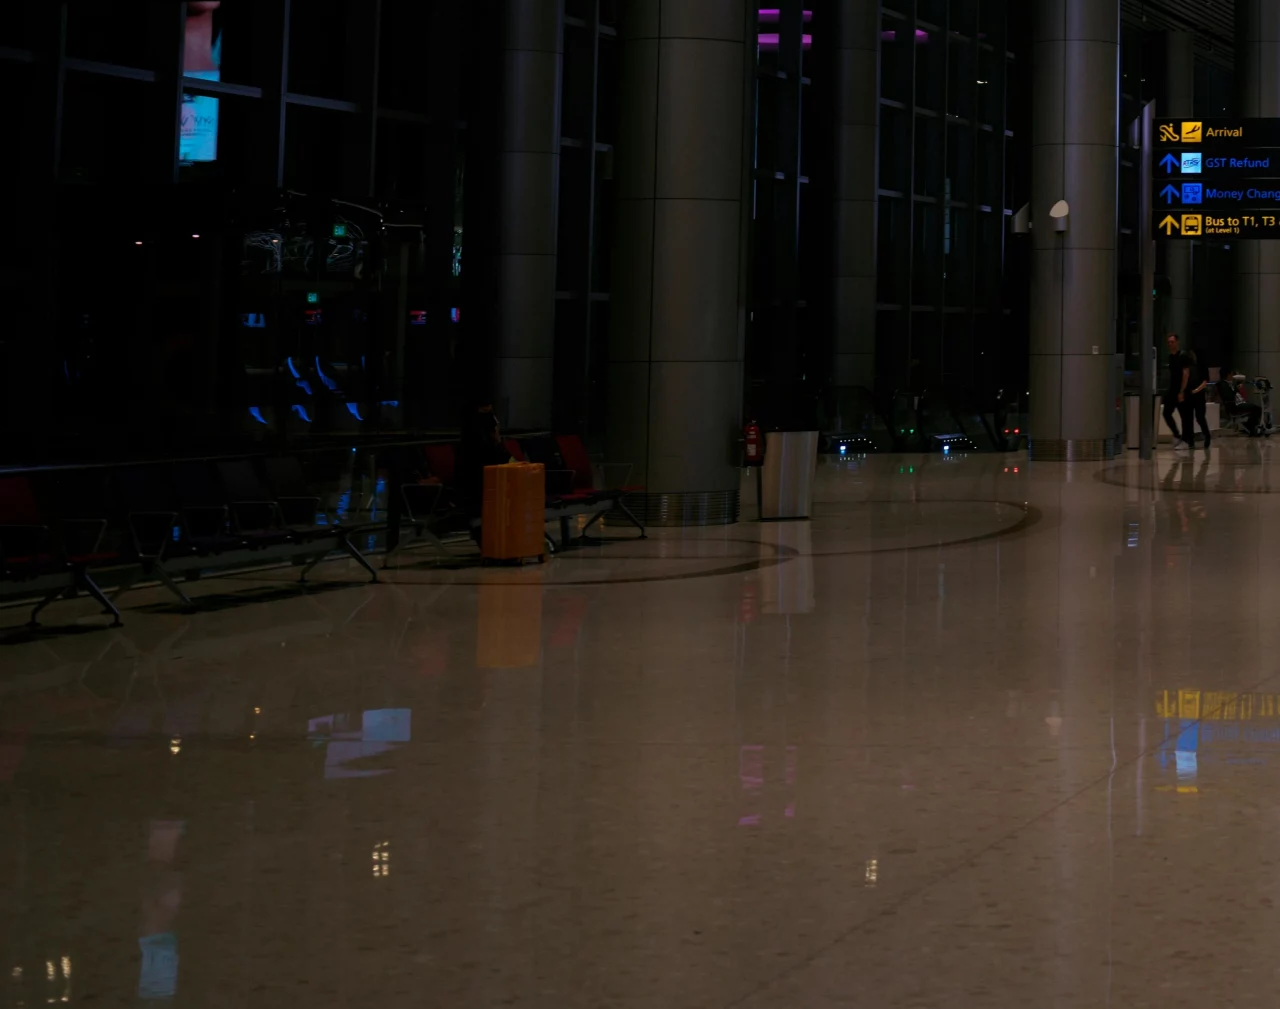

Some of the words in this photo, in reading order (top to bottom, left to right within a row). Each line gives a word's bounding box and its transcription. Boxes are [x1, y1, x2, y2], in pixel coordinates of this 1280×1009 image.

[1206, 126, 1243, 137] Arrival
[1206, 158, 1227, 168] GST
[1229, 157, 1270, 168] Refund
[1206, 188, 1244, 200] Money
[1206, 217, 1224, 226] Bus
[1227, 217, 1239, 226] to
[1242, 217, 1259, 227] T1,
[1262, 217, 1275, 226] T3
